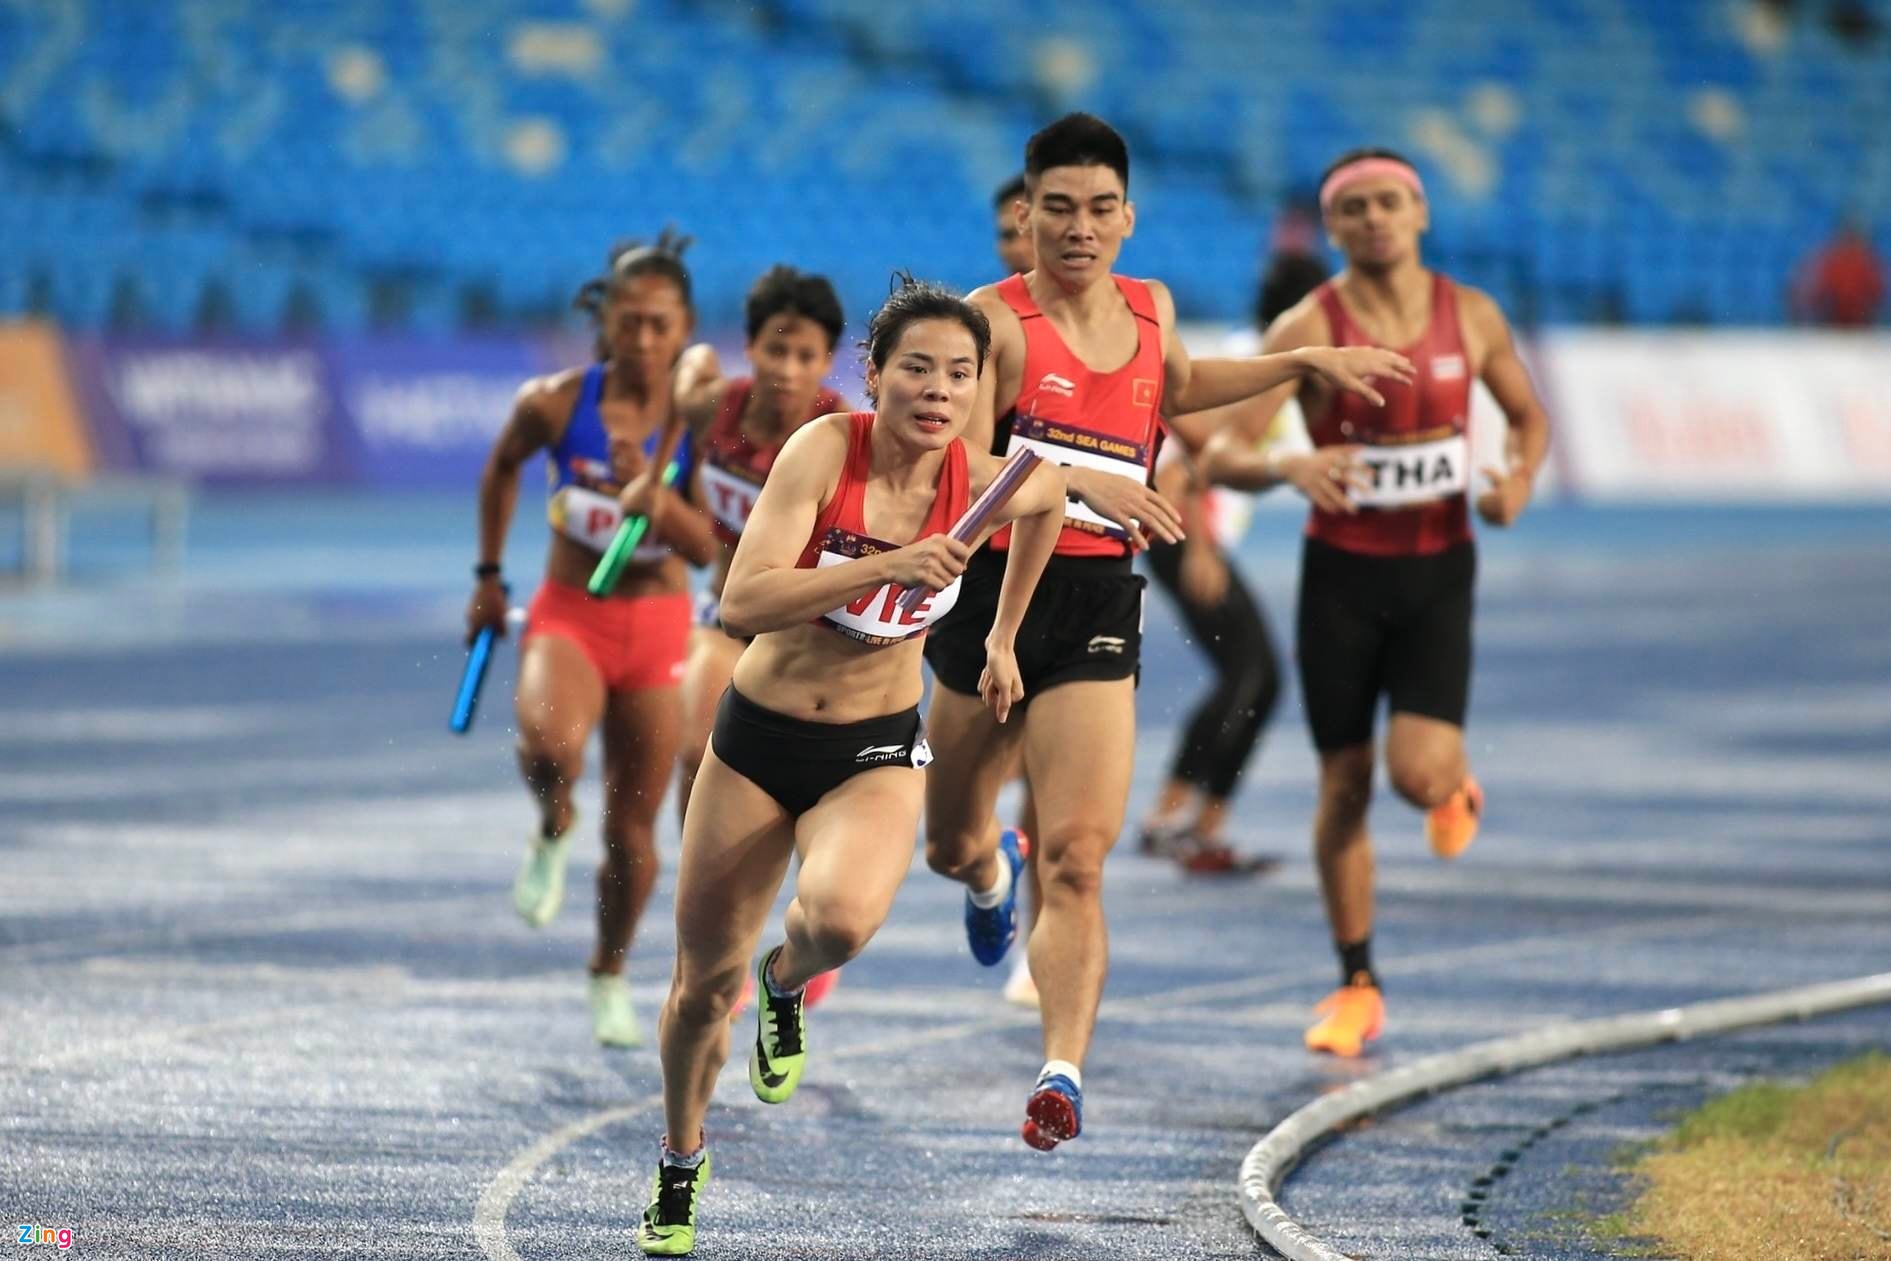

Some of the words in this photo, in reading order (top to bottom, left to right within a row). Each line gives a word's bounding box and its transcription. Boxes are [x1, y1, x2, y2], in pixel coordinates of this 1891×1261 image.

[1075, 433, 1099, 449] SEA
[1099, 439, 1137, 459] GAMES
[1364, 454, 1454, 489] THA
